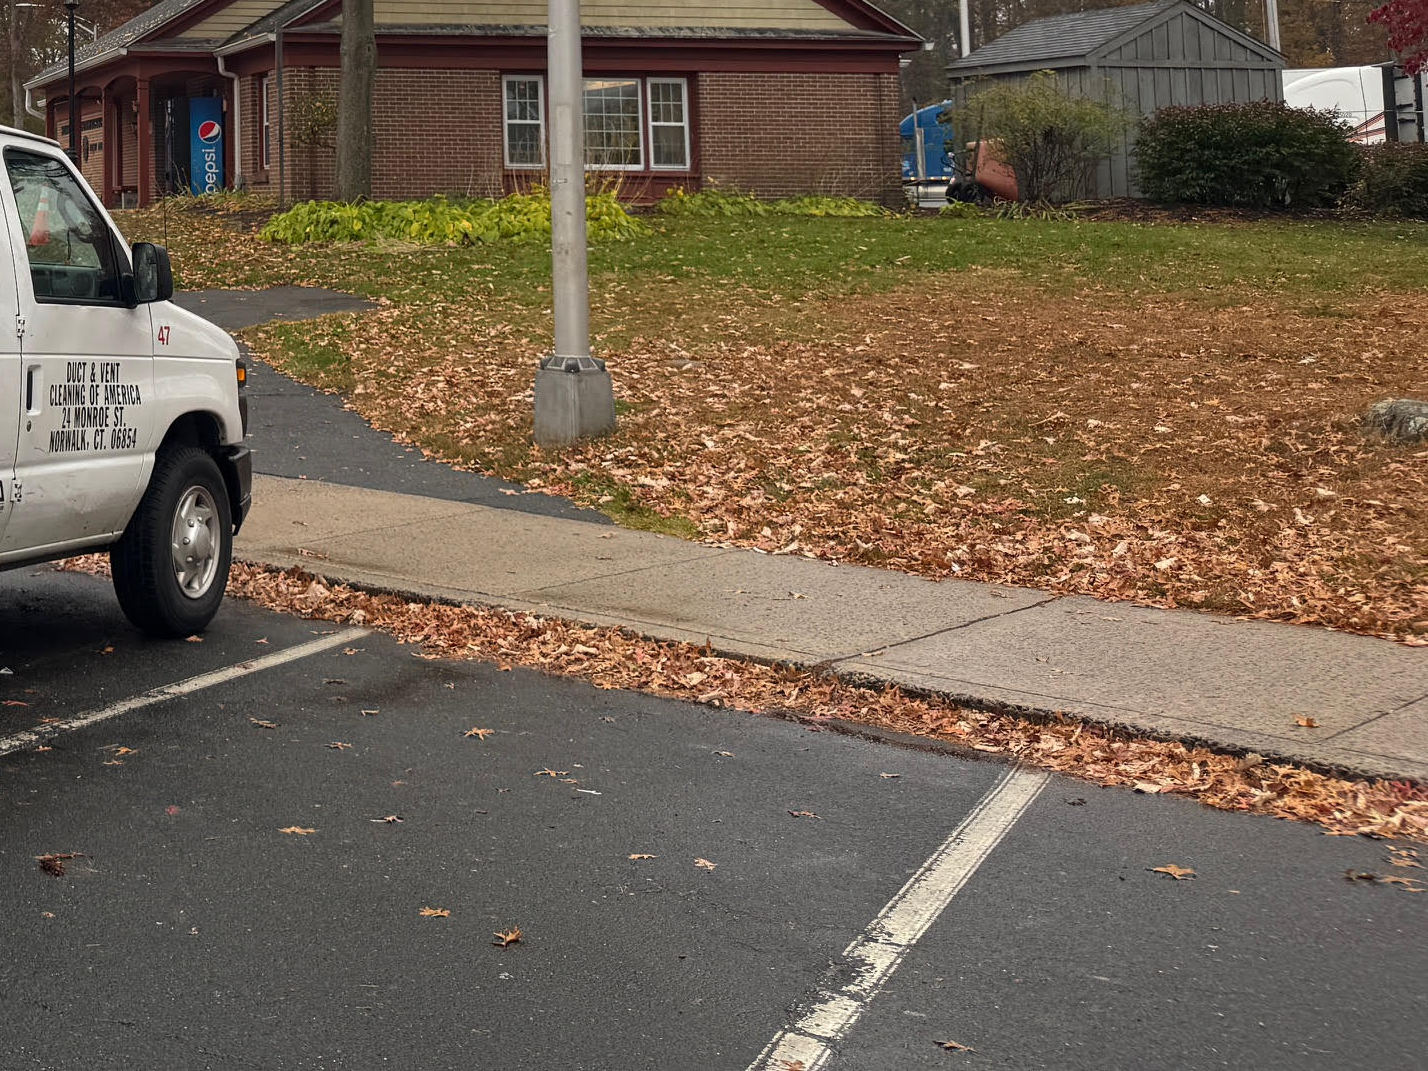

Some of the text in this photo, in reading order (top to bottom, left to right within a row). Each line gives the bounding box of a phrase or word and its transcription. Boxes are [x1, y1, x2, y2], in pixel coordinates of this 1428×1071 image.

[158, 326, 170, 345] 47
[66, 362, 120, 384] DUCT & VENT
[49, 384, 141, 406] CLEANING OF AMERICA
[62, 407, 126, 429] 24 MONROE ST.
[49, 428, 137, 453] NORWALK, CT. 06854
